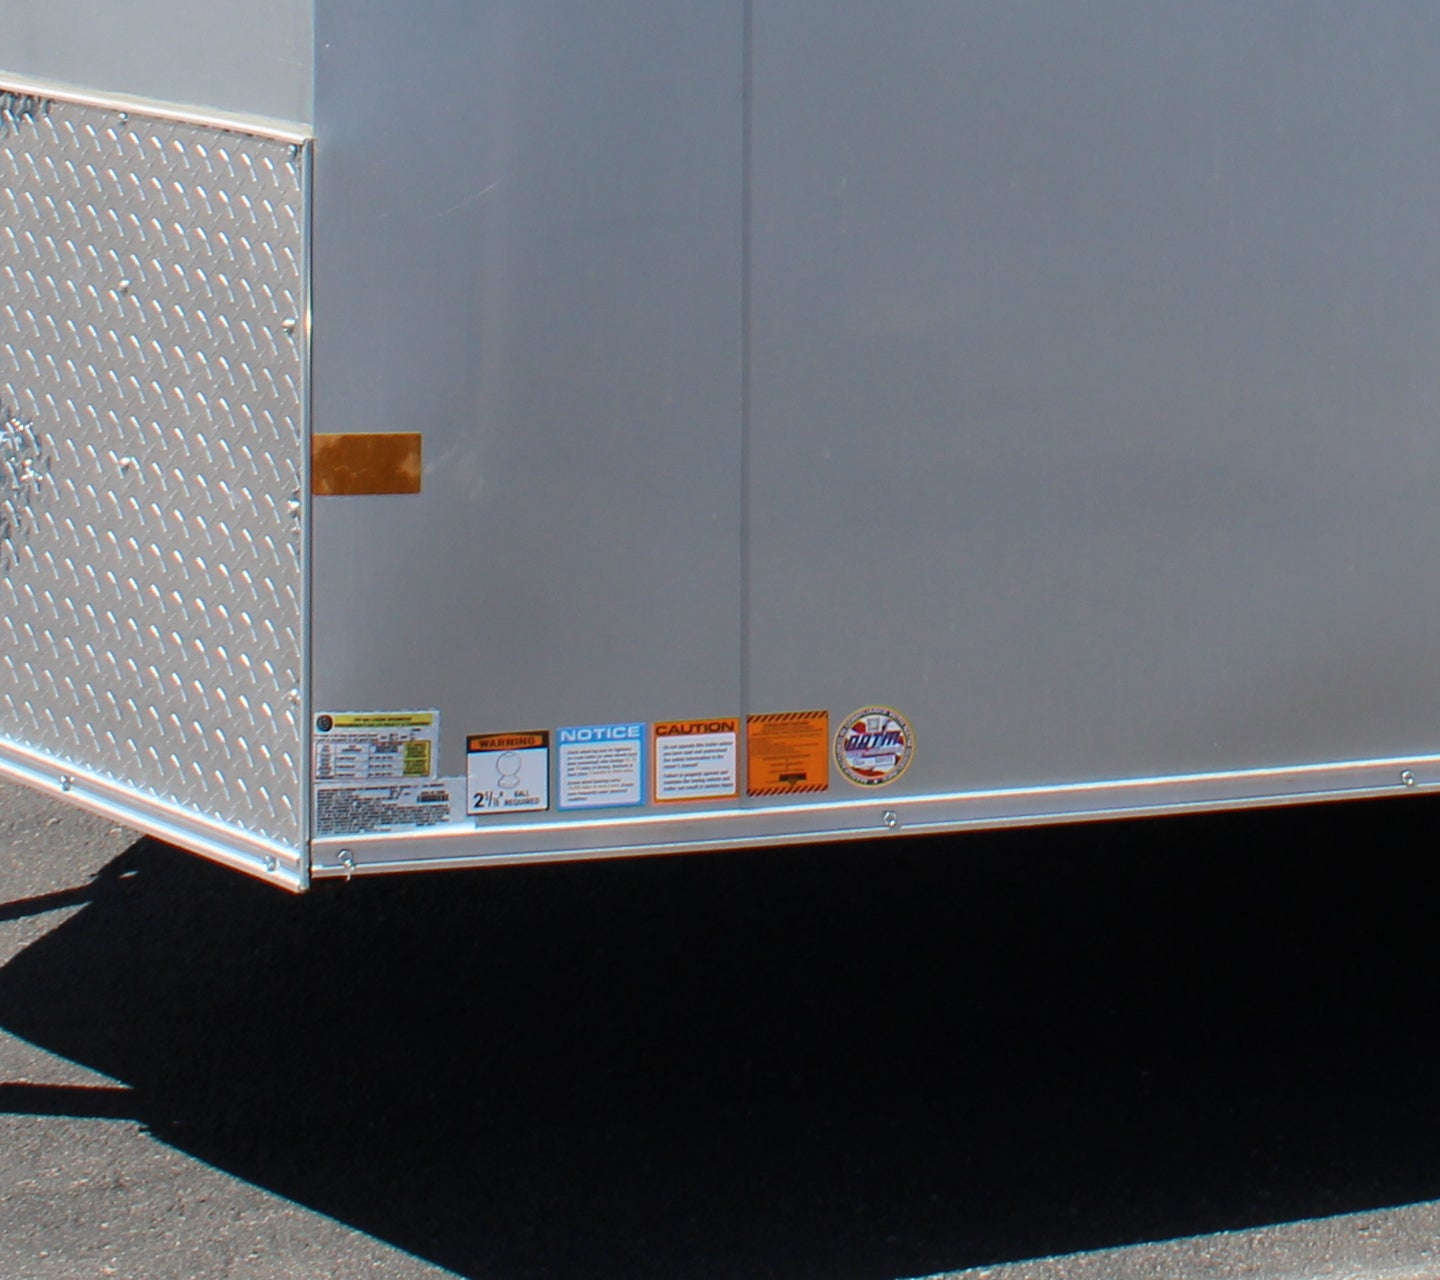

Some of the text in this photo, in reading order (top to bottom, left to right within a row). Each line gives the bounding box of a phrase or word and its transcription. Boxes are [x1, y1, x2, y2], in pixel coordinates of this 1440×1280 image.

[560, 726, 641, 742] NOTICE
[655, 721, 735, 737] CAUTION
[478, 737, 536, 748] WARNING
